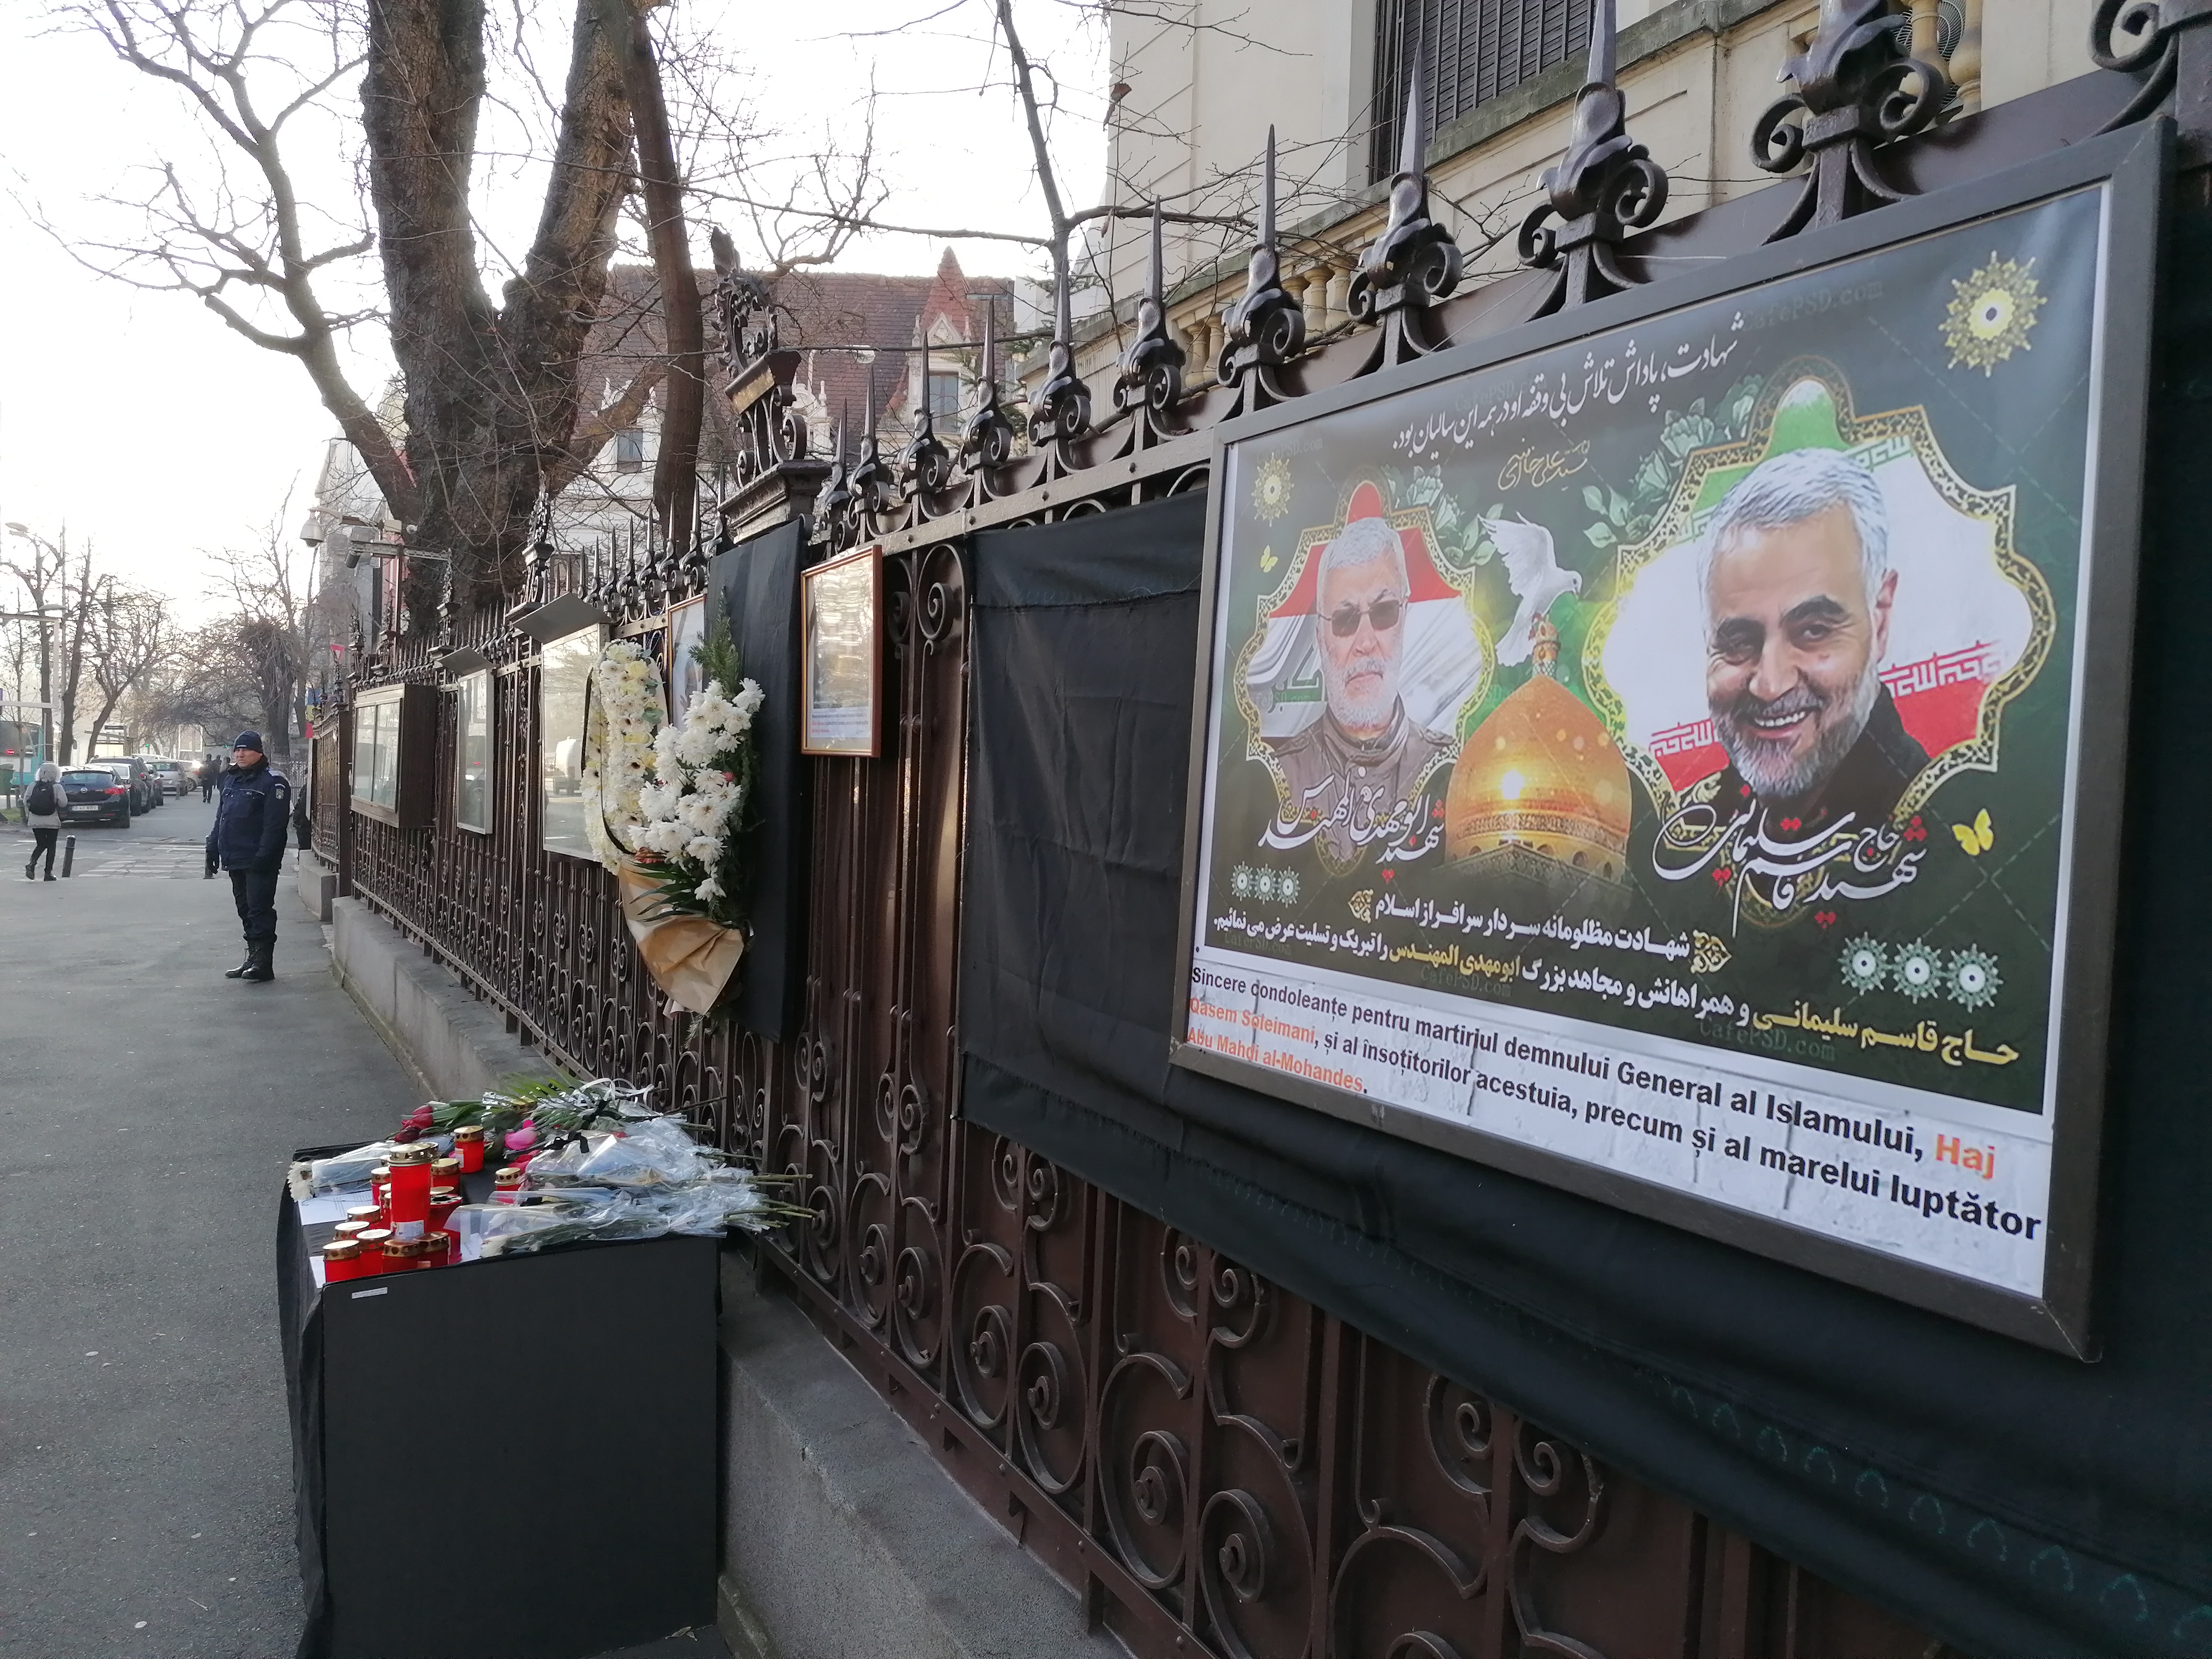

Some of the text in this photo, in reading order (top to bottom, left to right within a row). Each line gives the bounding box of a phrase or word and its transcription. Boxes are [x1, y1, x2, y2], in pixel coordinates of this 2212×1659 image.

[1566, 351, 1616, 415] تلاش
[1606, 338, 1661, 414] پاداش
[1453, 404, 1479, 450] این
[1374, 892, 1421, 920] اسلام
[1264, 916, 1296, 943] عرض
[1295, 922, 1332, 946] تسلیت
[1329, 933, 1338, 952] و
[1542, 914, 1613, 950] مظلومانه
[1614, 926, 1691, 962] شهادت
[1389, 943, 1460, 968] المهندس
[1521, 958, 1567, 993] بزرگ
[1567, 967, 1623, 1000] مجاهد
[1623, 983, 1636, 1006] و
[1735, 1003, 1750, 1026] و
[1751, 1000, 1859, 1042] سلیمانی
[1860, 1021, 1938, 1050] قاسم
[1940, 1029, 2020, 1066] حاج
[1187, 1026, 1368, 1095] Abu Mahdi al-Mohandes.
[1191, 966, 1246, 996] Sincere
[1352, 1002, 1410, 1032] pentru
[1504, 1035, 1610, 1080] demnului
[1617, 1061, 1721, 1107] General
[1730, 1090, 1756, 1116] al
[1767, 1094, 1924, 1162] Islamului,
[1935, 1134, 1995, 1180] Haj
[1190, 997, 1238, 1021] Qasem
[1241, 1010, 1319, 1048] Soleimani,
[1343, 1035, 1358, 1056] al
[1475, 1071, 1578, 1118] acestuia,
[1585, 1099, 1683, 1142] precum
[1692, 1126, 1716, 1157] și
[1724, 1134, 1750, 1161] al
[1759, 1146, 1880, 1197] marelui
[1890, 1175, 2043, 1241] luptător
